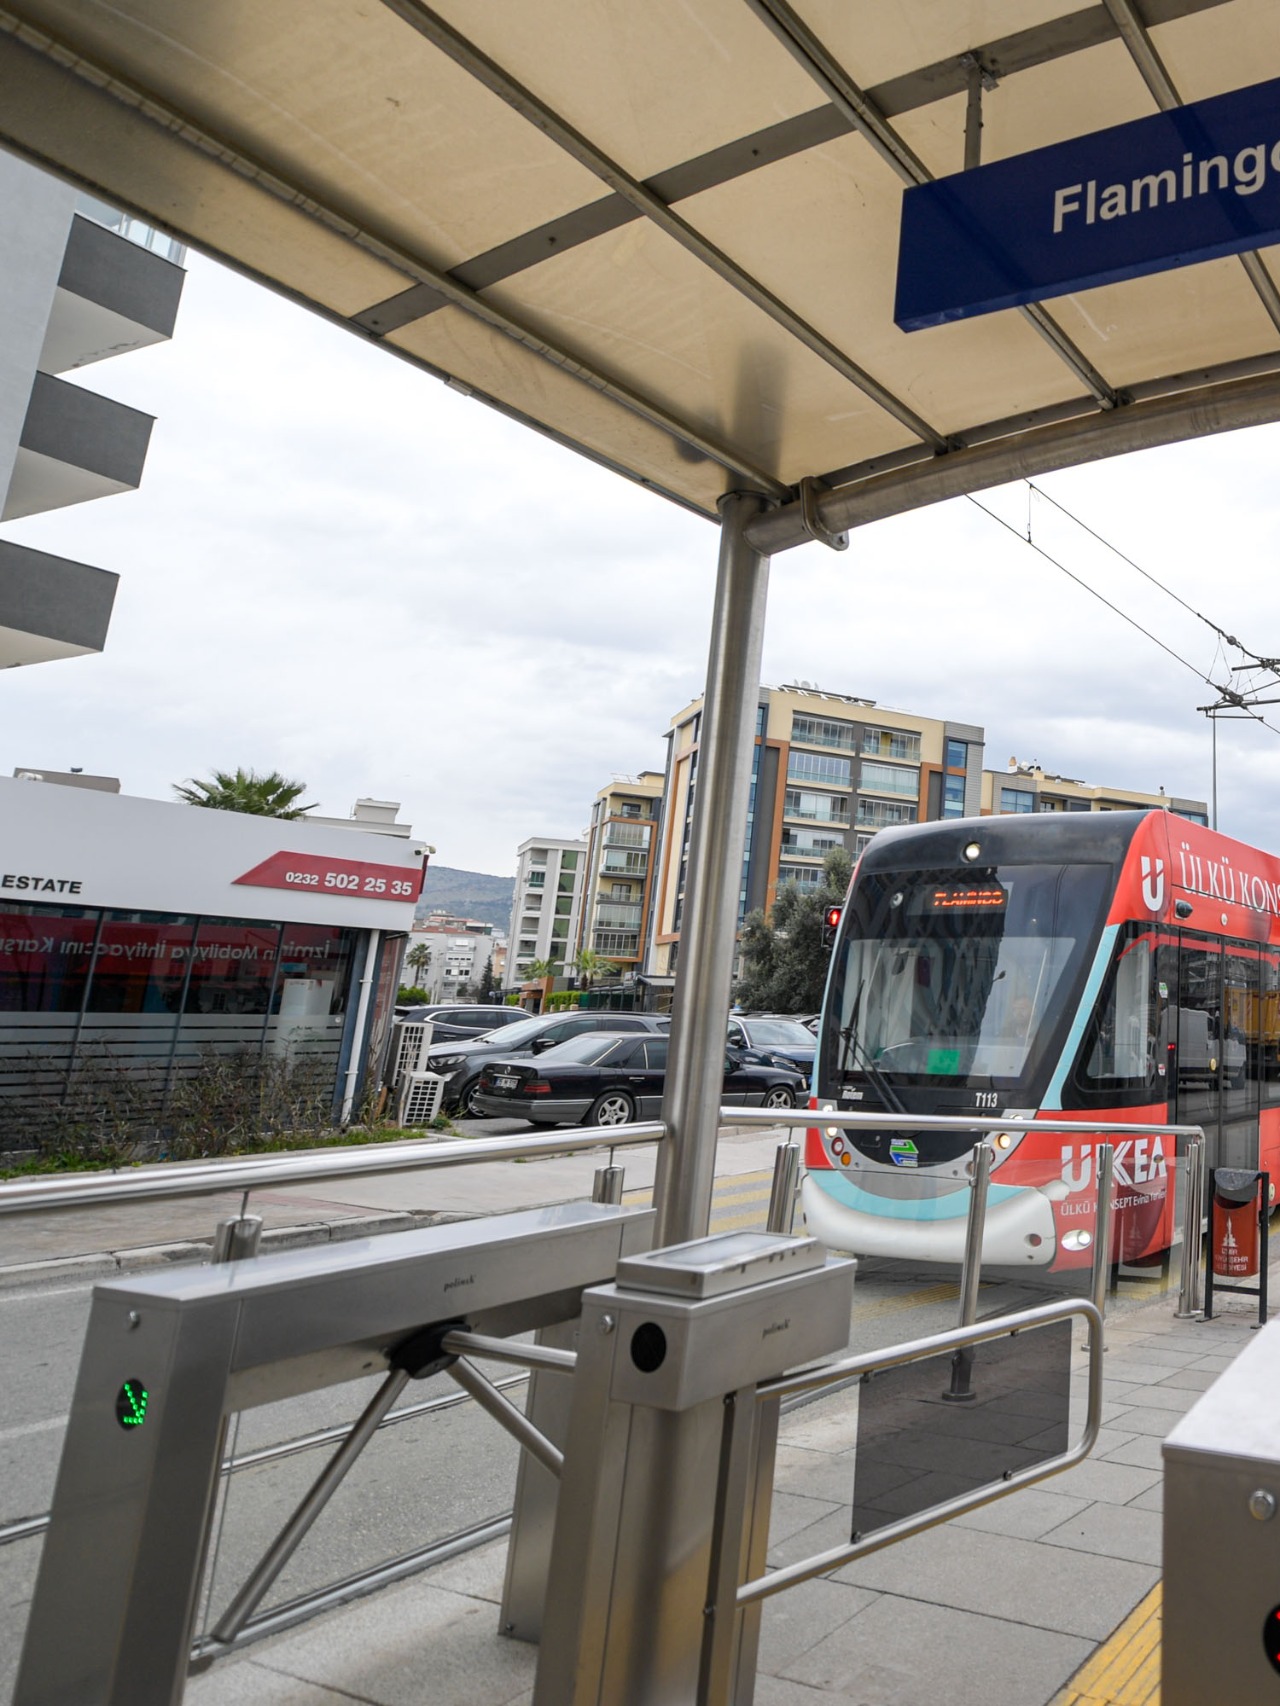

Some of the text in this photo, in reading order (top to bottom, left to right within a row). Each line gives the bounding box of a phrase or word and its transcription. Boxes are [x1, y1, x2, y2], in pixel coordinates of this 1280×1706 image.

[286, 871, 413, 896] 0232 502 25 35
[1179, 842, 1236, 905] ÜLKÜ
[2, 874, 83, 895] ESTATE
[975, 1092, 998, 1108] T113
[1061, 1201, 1090, 1216] ÜLKÜ
